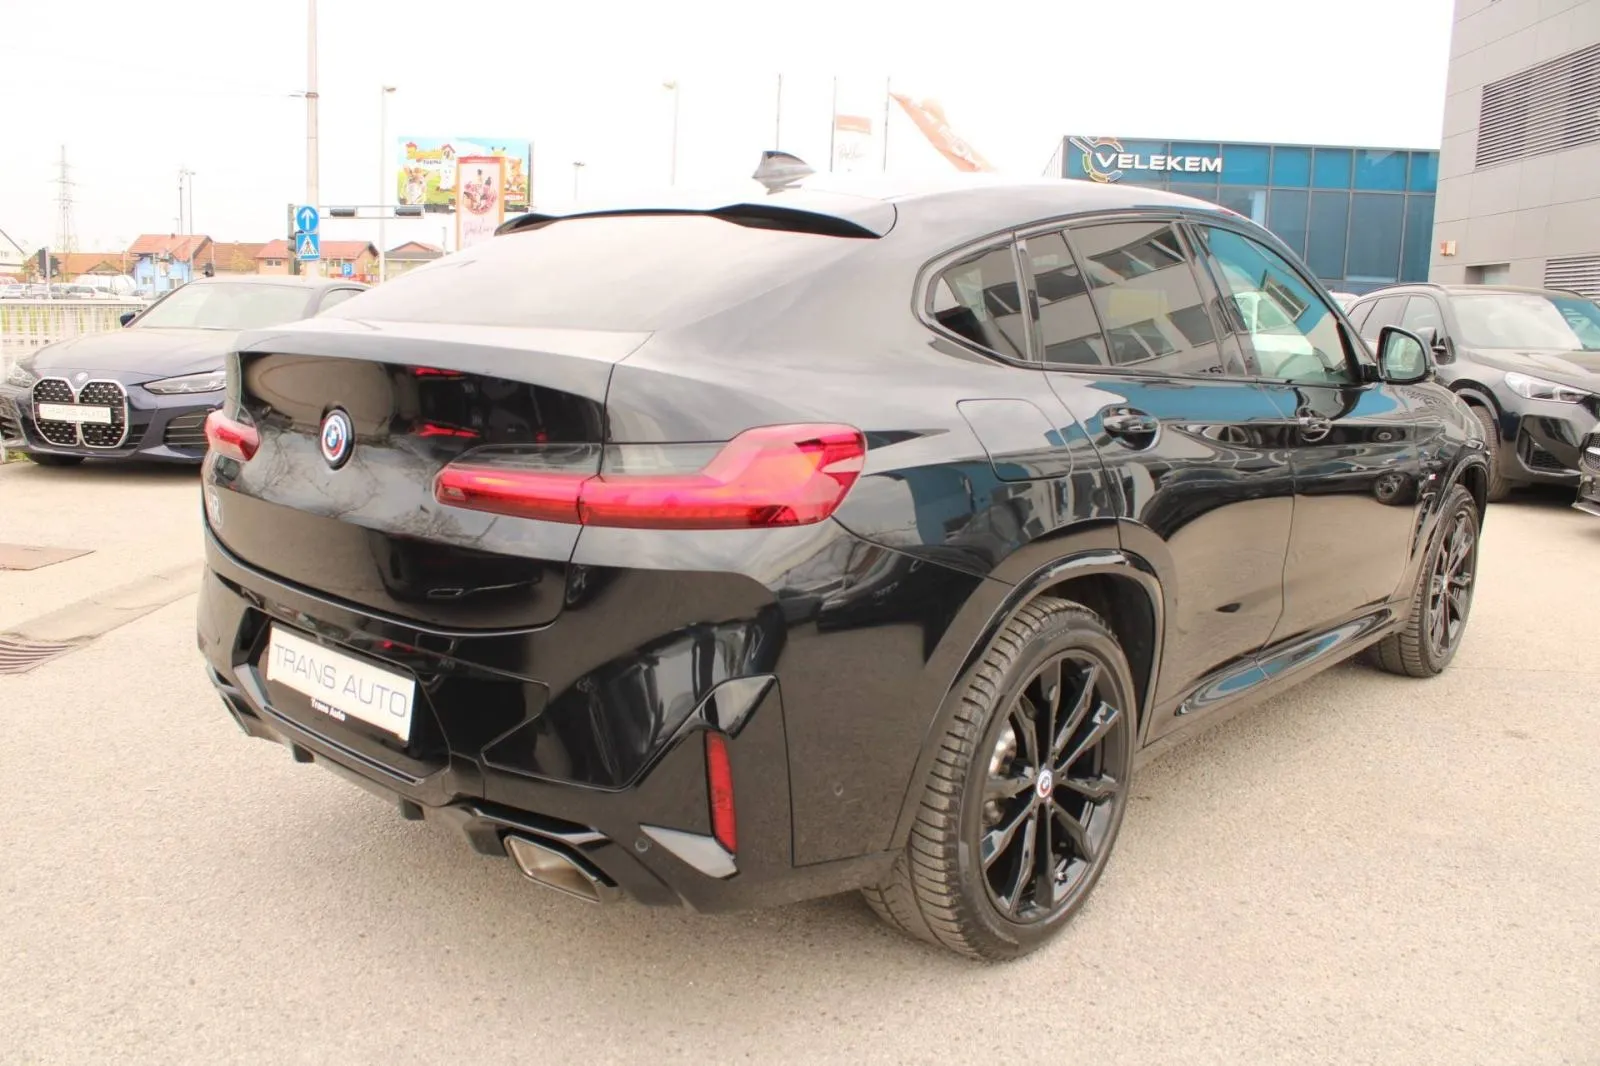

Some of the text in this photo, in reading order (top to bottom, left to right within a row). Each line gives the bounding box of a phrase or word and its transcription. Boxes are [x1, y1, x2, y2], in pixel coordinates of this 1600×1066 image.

[1095, 152, 1223, 173] VELEKEM
[274, 643, 407, 718] TRANS AUTO
